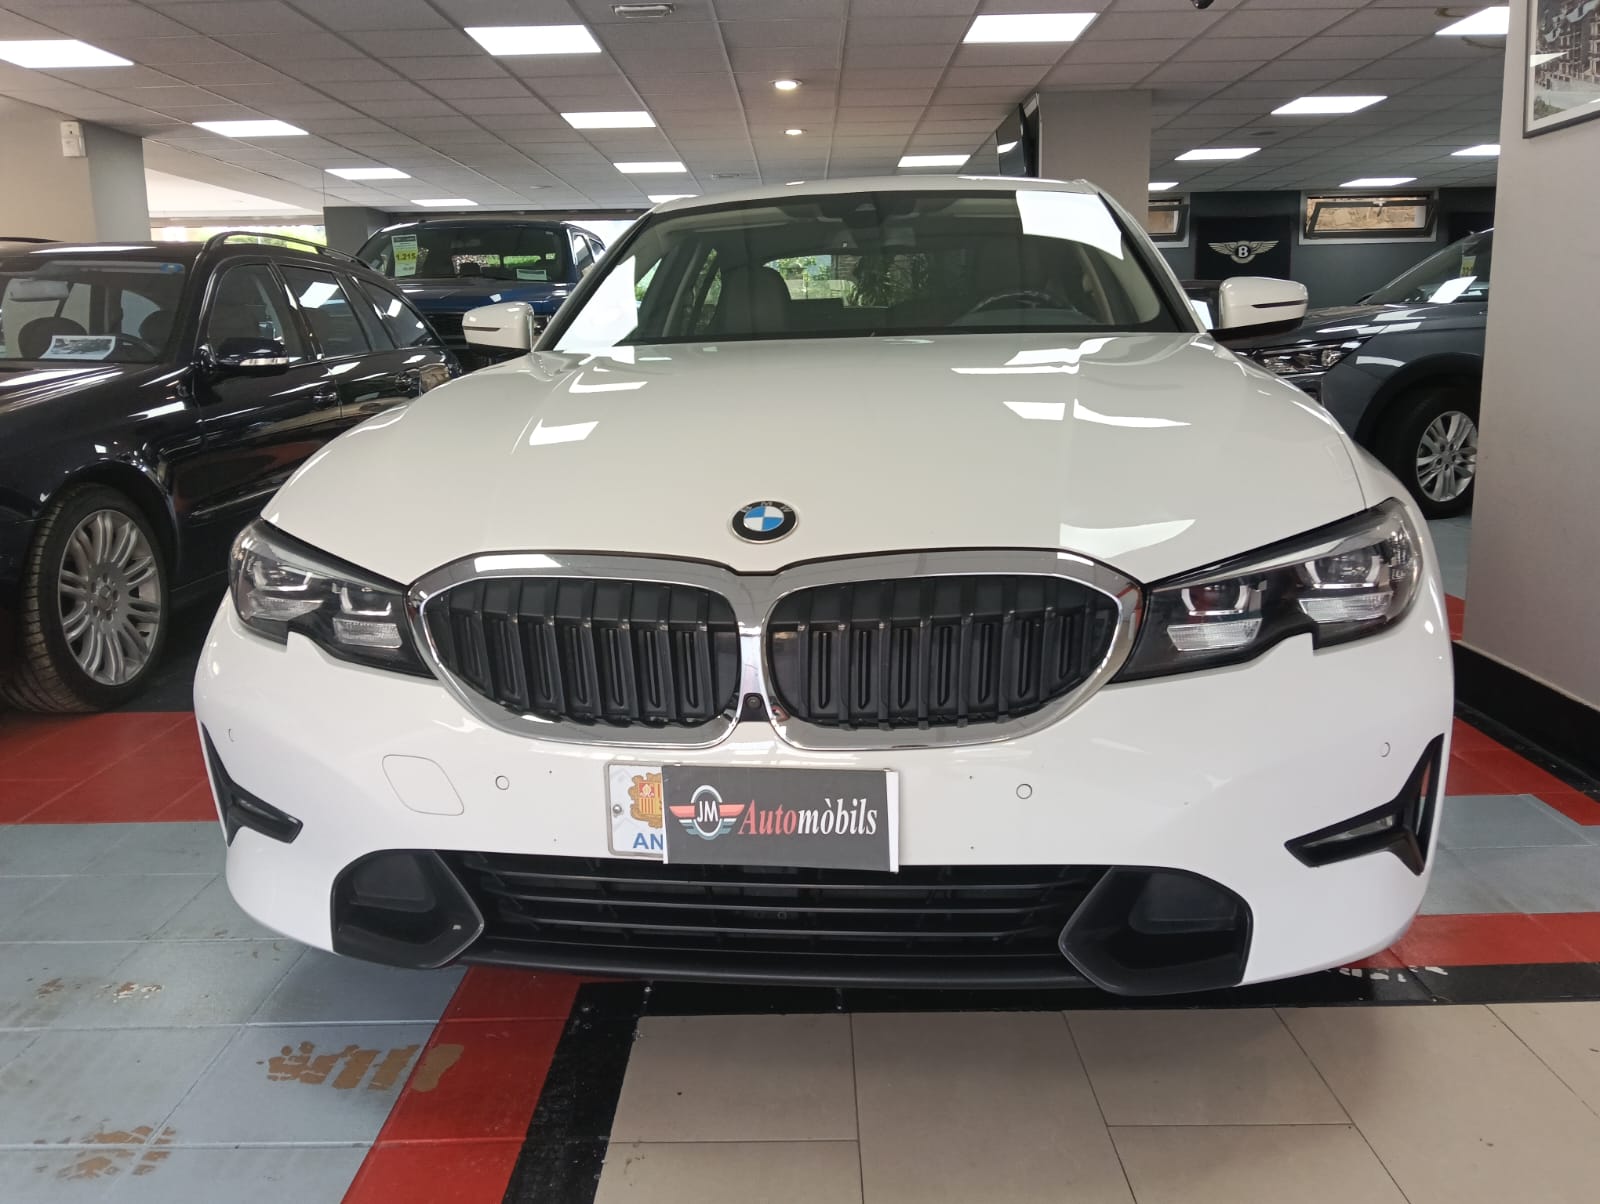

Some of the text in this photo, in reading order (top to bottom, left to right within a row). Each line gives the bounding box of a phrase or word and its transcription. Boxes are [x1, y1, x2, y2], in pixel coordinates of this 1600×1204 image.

[1238, 246, 1249, 258] B
[696, 798, 878, 836] JM Automòbils
